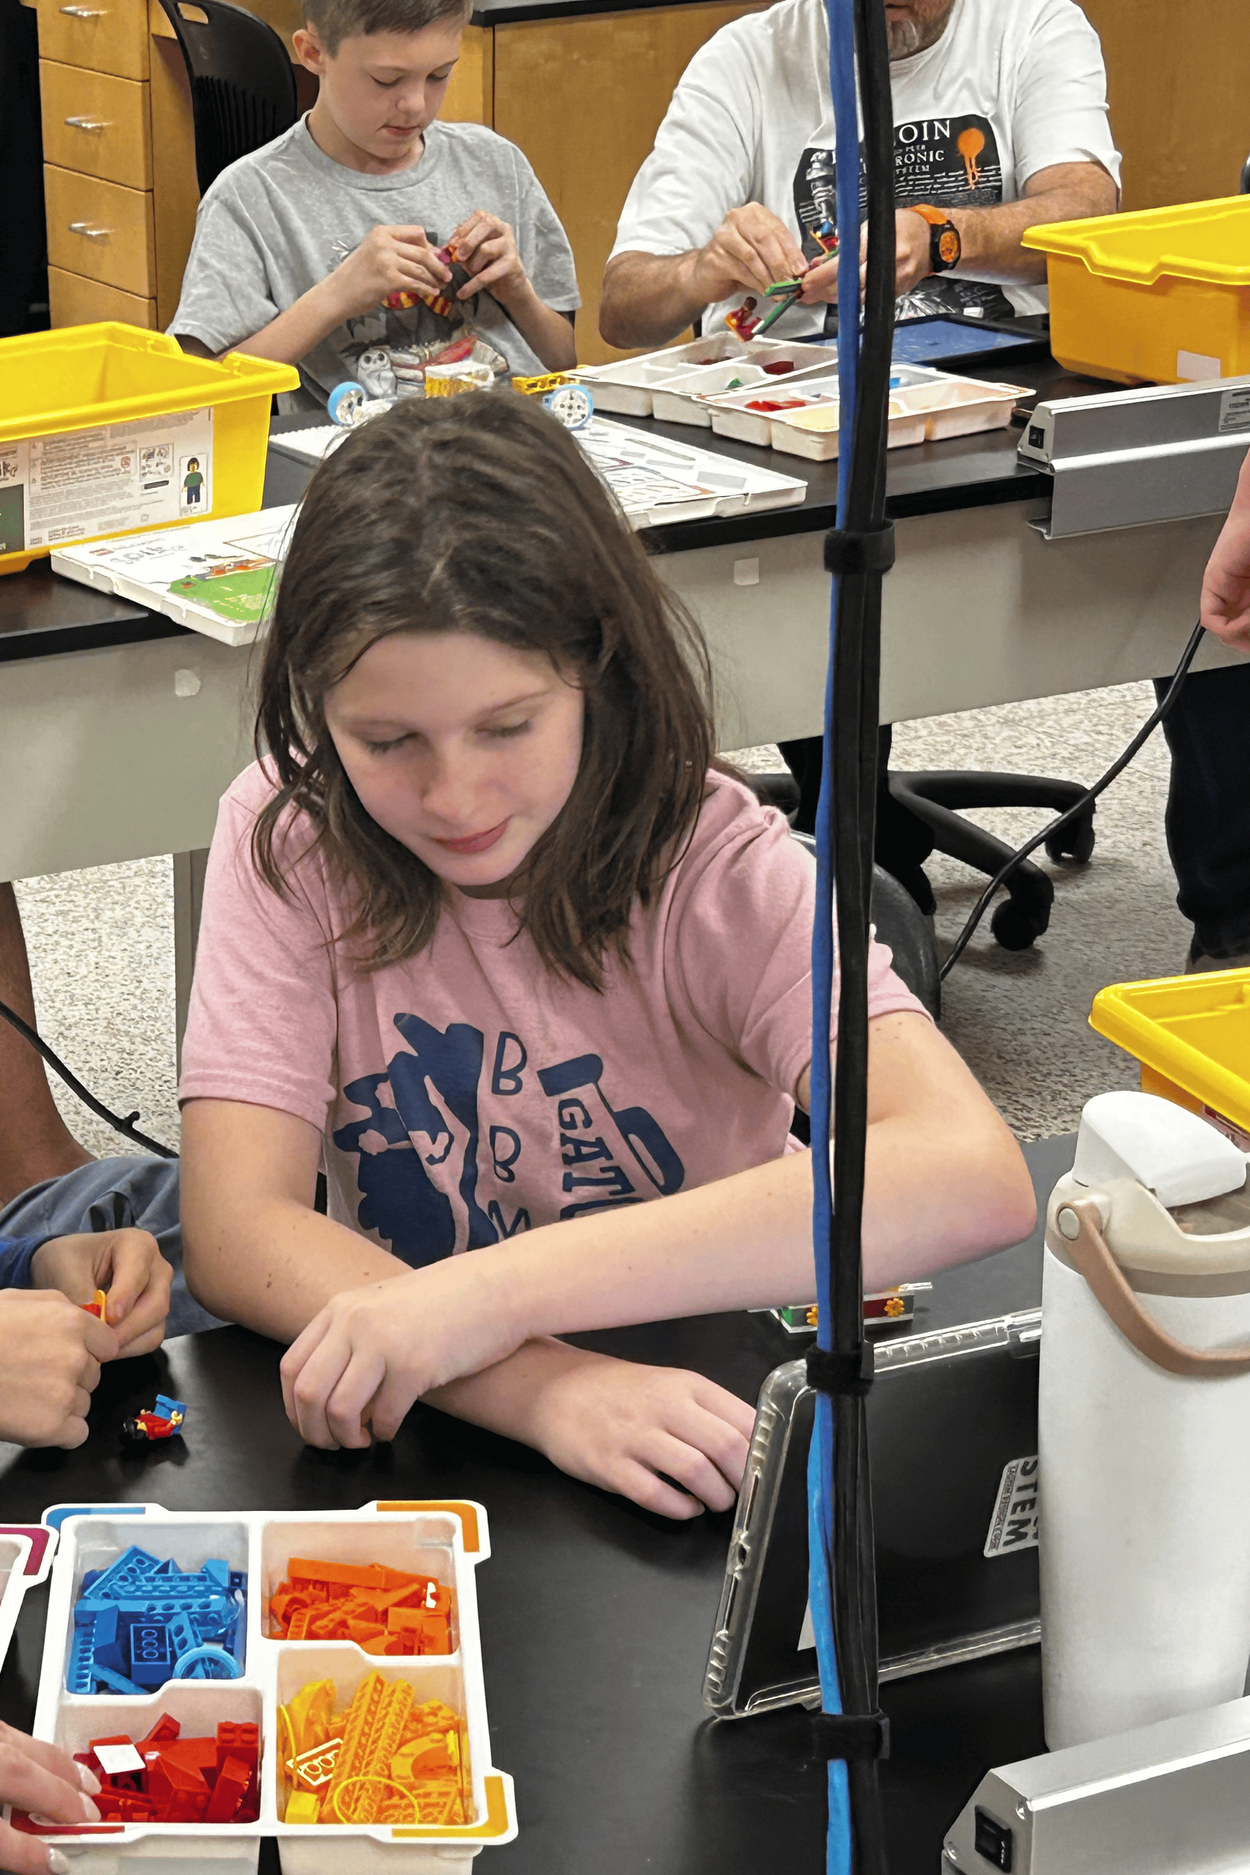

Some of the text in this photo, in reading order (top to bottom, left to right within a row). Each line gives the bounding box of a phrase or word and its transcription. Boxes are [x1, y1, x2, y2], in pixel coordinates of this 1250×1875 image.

[898, 119, 951, 144] OIN
[895, 150, 945, 166] RONIC
[1002, 1459, 1038, 1547] STEM
